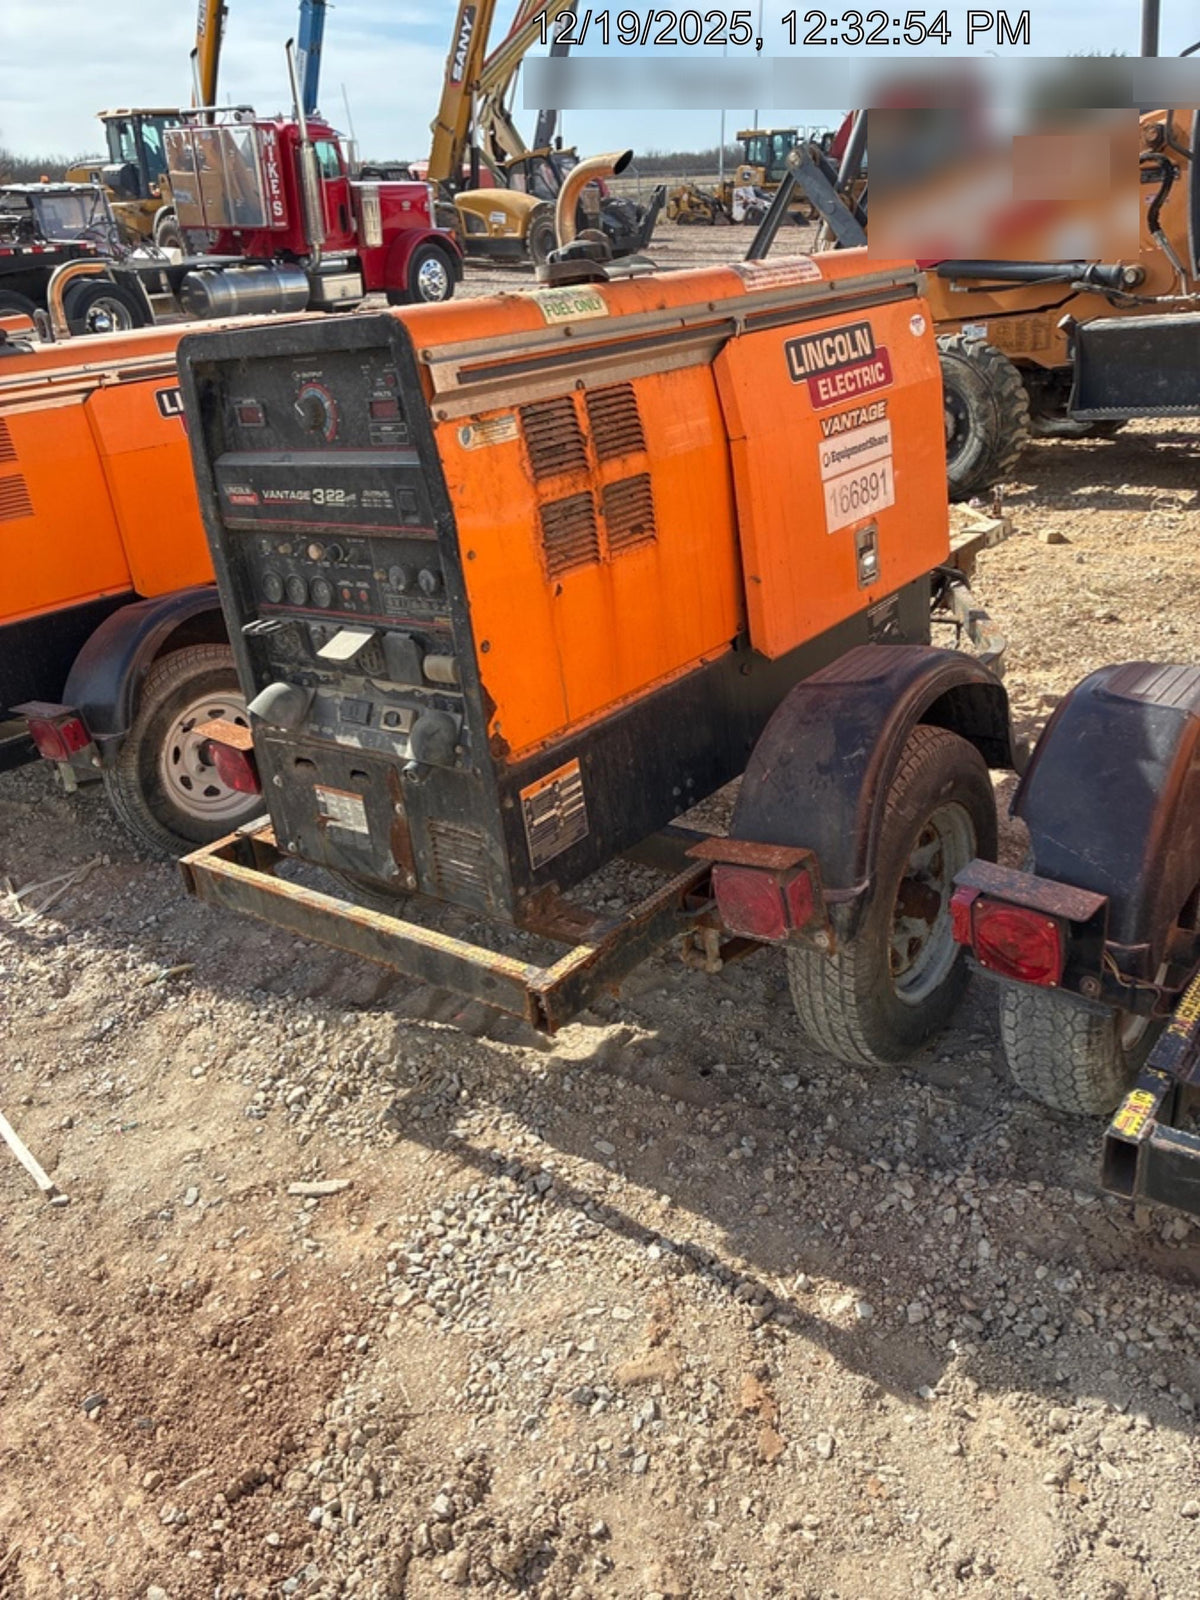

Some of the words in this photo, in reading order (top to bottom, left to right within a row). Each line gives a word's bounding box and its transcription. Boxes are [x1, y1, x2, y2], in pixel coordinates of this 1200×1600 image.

[452, 13, 473, 81] SANY
[544, 301, 574, 317] FUEL
[790, 328, 872, 376] LINCOLN
[817, 362, 886, 401] ELECTRIC
[820, 400, 888, 436] VANTAGE
[262, 489, 311, 501] VANTAGE
[312, 488, 345, 505] 322
[830, 468, 888, 518] 166891
